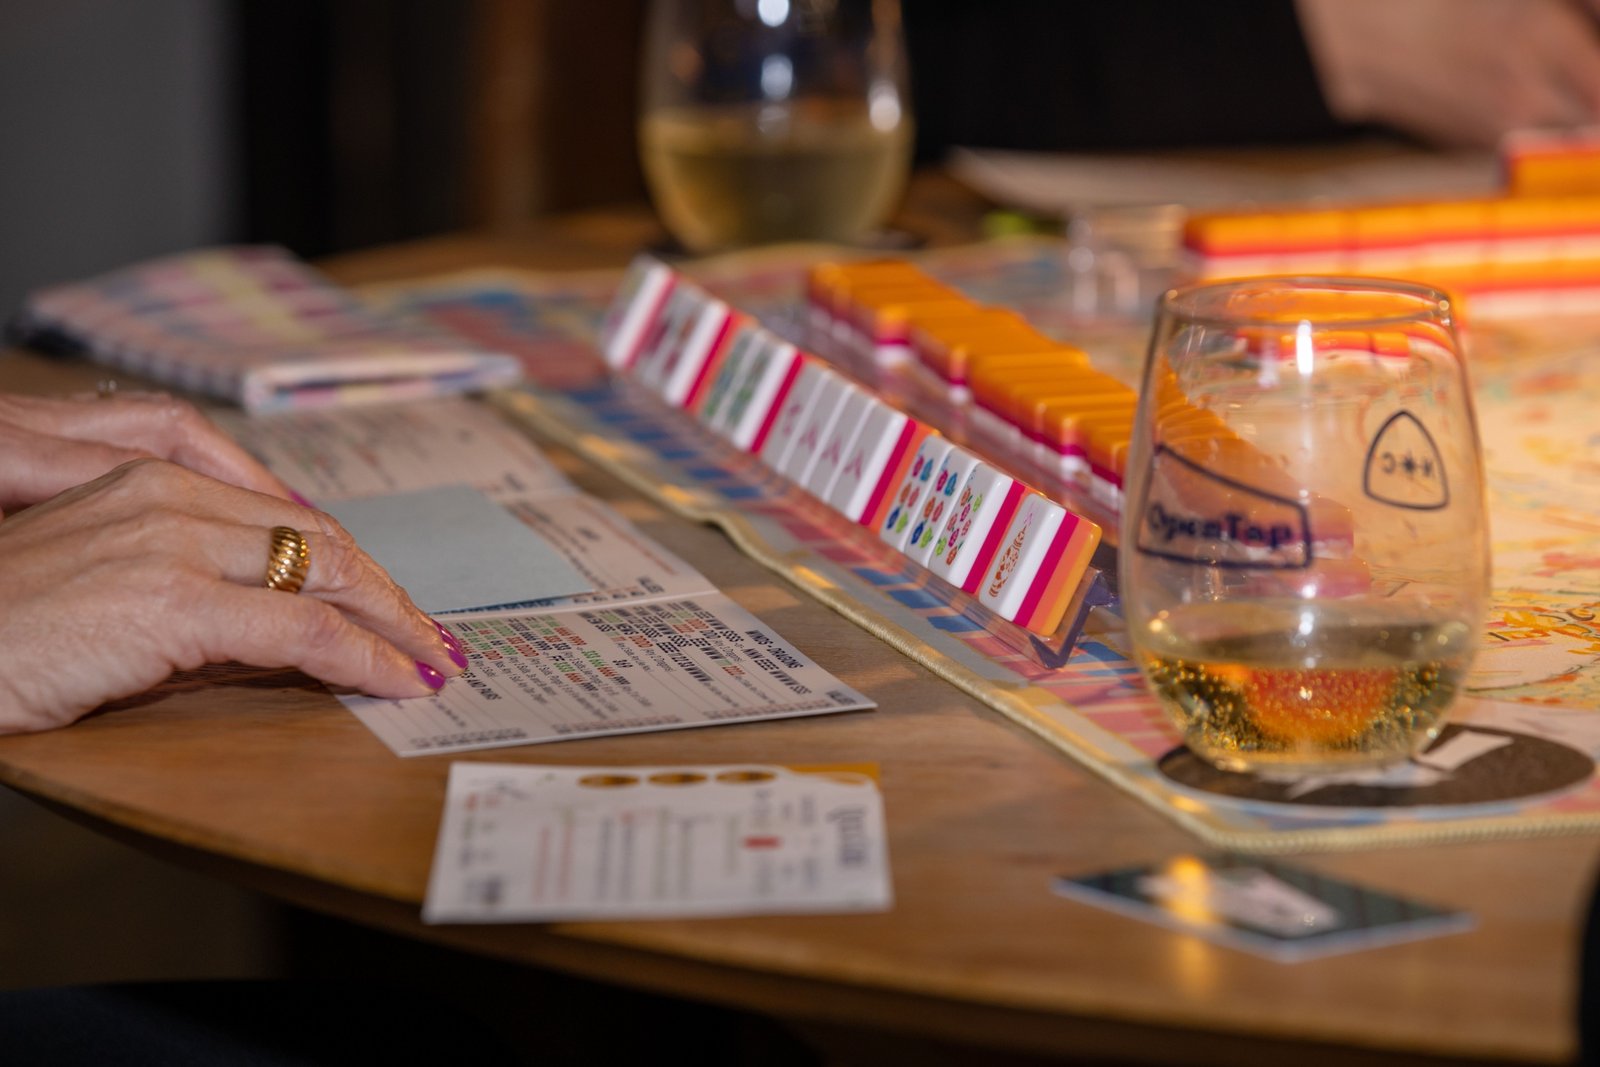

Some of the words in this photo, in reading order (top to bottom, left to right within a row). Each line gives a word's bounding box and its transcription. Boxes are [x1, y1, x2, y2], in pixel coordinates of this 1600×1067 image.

[1146, 502, 1293, 551] OpenTap
[611, 623, 640, 635] NEWS
[511, 644, 541, 657] DDDD
[549, 642, 573, 650] 333
[653, 641, 682, 653] EEEE
[479, 650, 505, 660] DDD
[578, 650, 603, 658] 333
[763, 647, 807, 668] DRAGONS
[550, 661, 578, 672] 3333
[610, 659, 634, 668] 369
[751, 658, 781, 670] EEEE
[463, 678, 488, 688] AND
